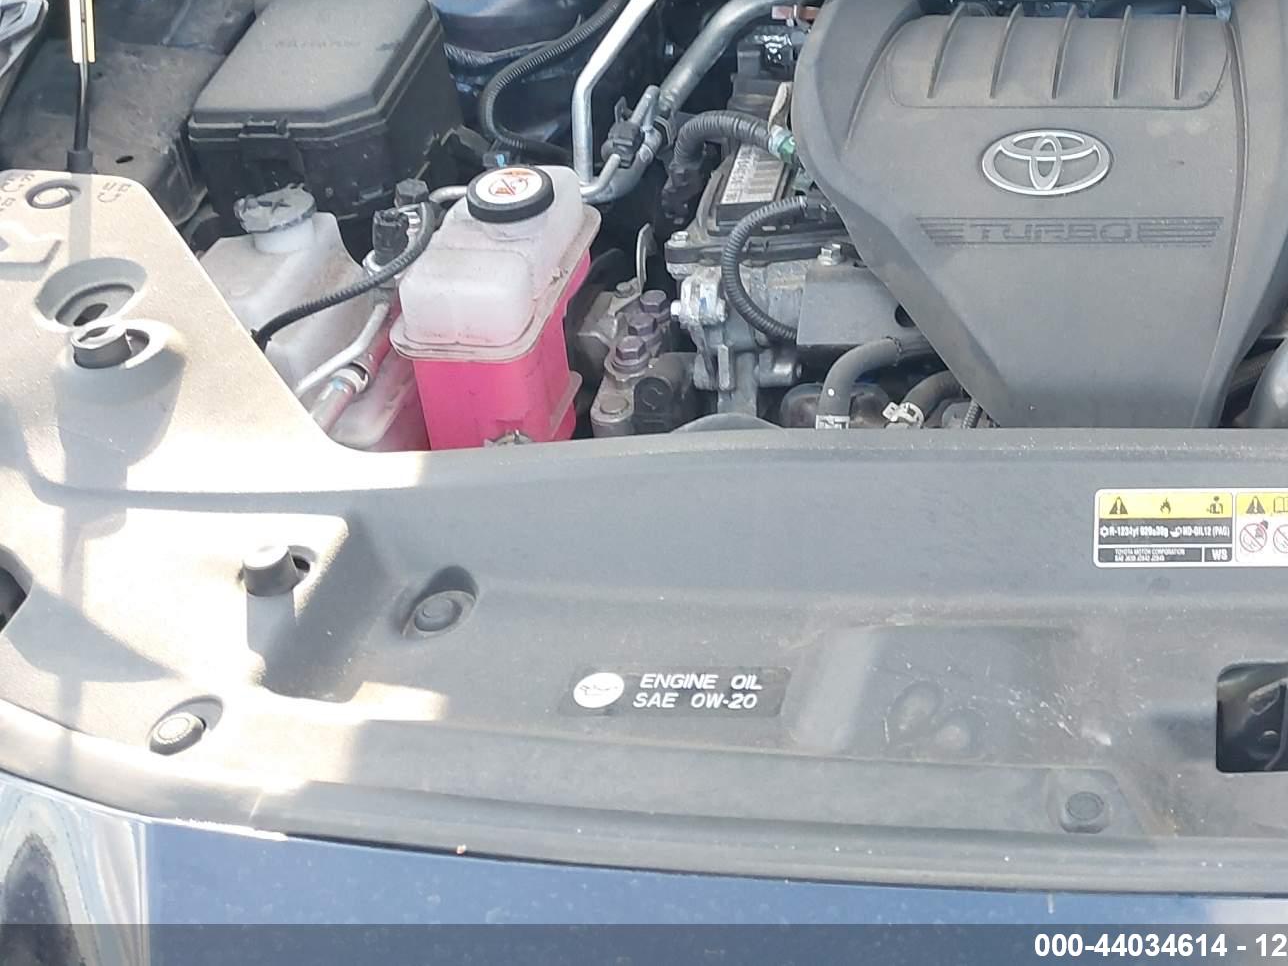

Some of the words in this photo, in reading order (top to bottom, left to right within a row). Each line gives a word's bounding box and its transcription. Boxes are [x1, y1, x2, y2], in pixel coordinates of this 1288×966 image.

[967, 222, 1132, 242] TURBO
[640, 673, 718, 689] ENGINE
[731, 674, 763, 690] OIL
[633, 692, 679, 708] SAE
[691, 693, 758, 709] 0W-20
